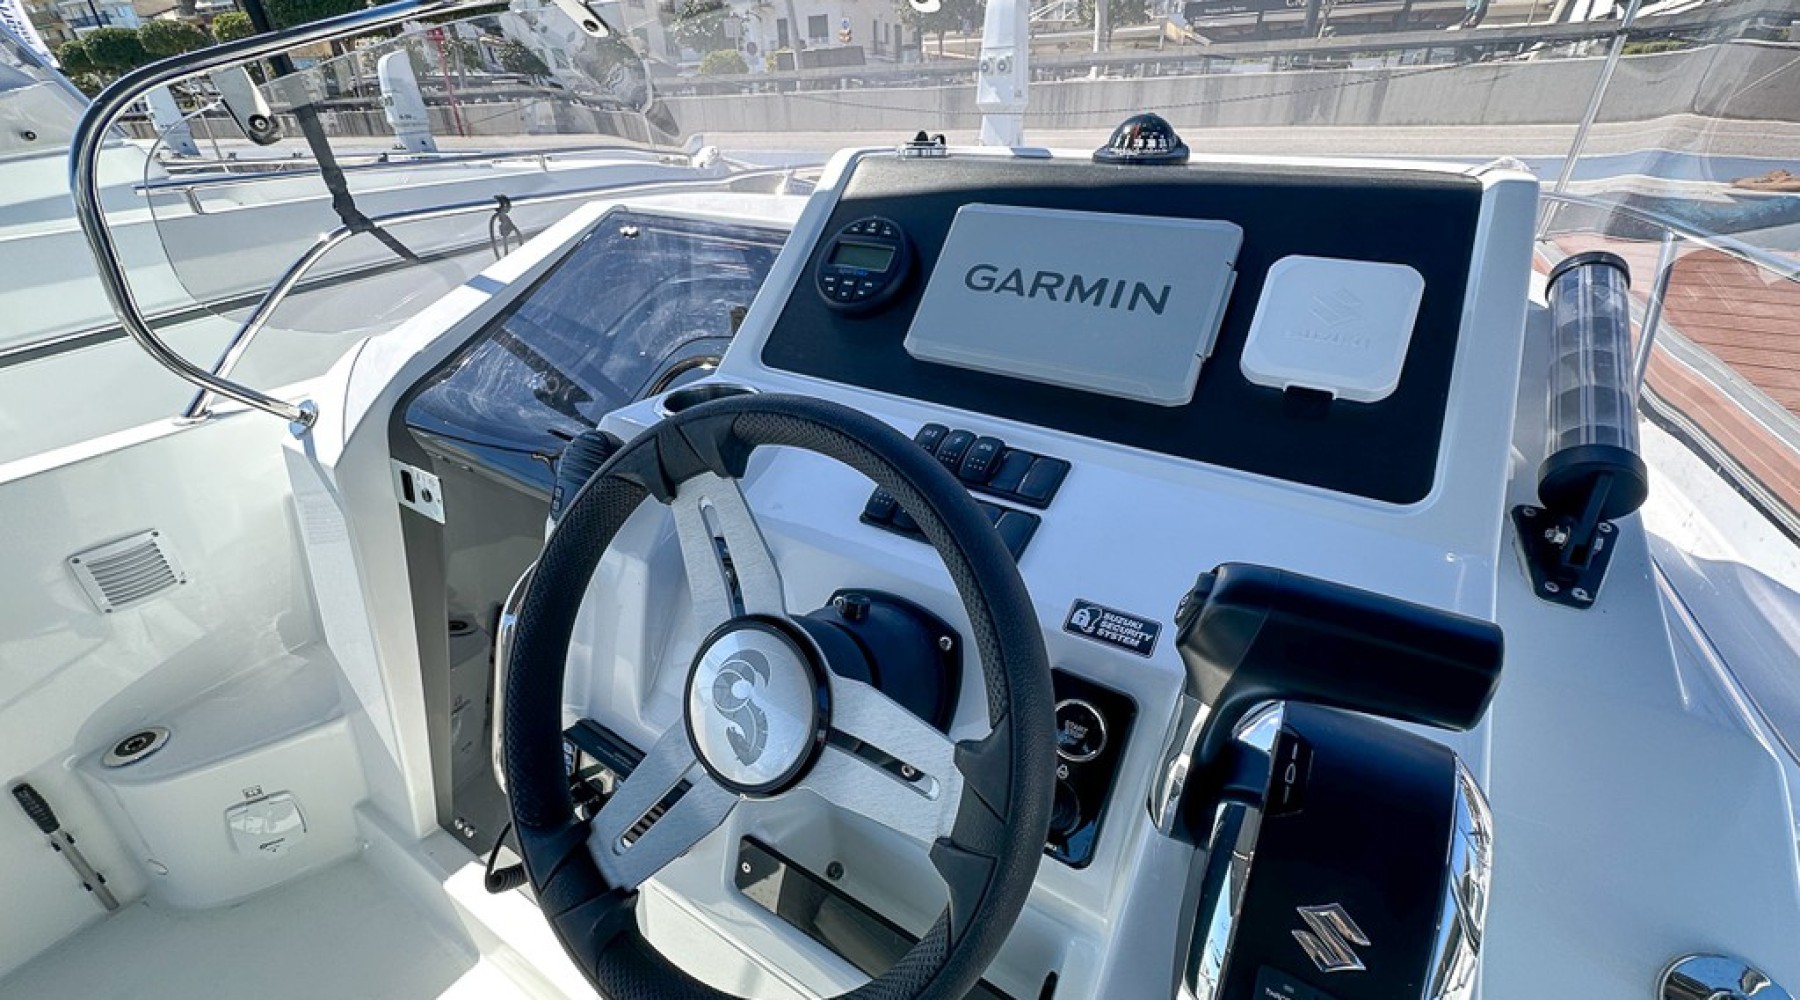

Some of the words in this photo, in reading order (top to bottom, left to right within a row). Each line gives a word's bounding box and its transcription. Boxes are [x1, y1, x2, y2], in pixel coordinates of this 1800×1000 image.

[964, 263, 1172, 316] GARMIN
[1103, 612, 1143, 630] SUZUKI
[1096, 630, 1140, 647] SYSTEM
[1101, 621, 1153, 641] SECURITY
